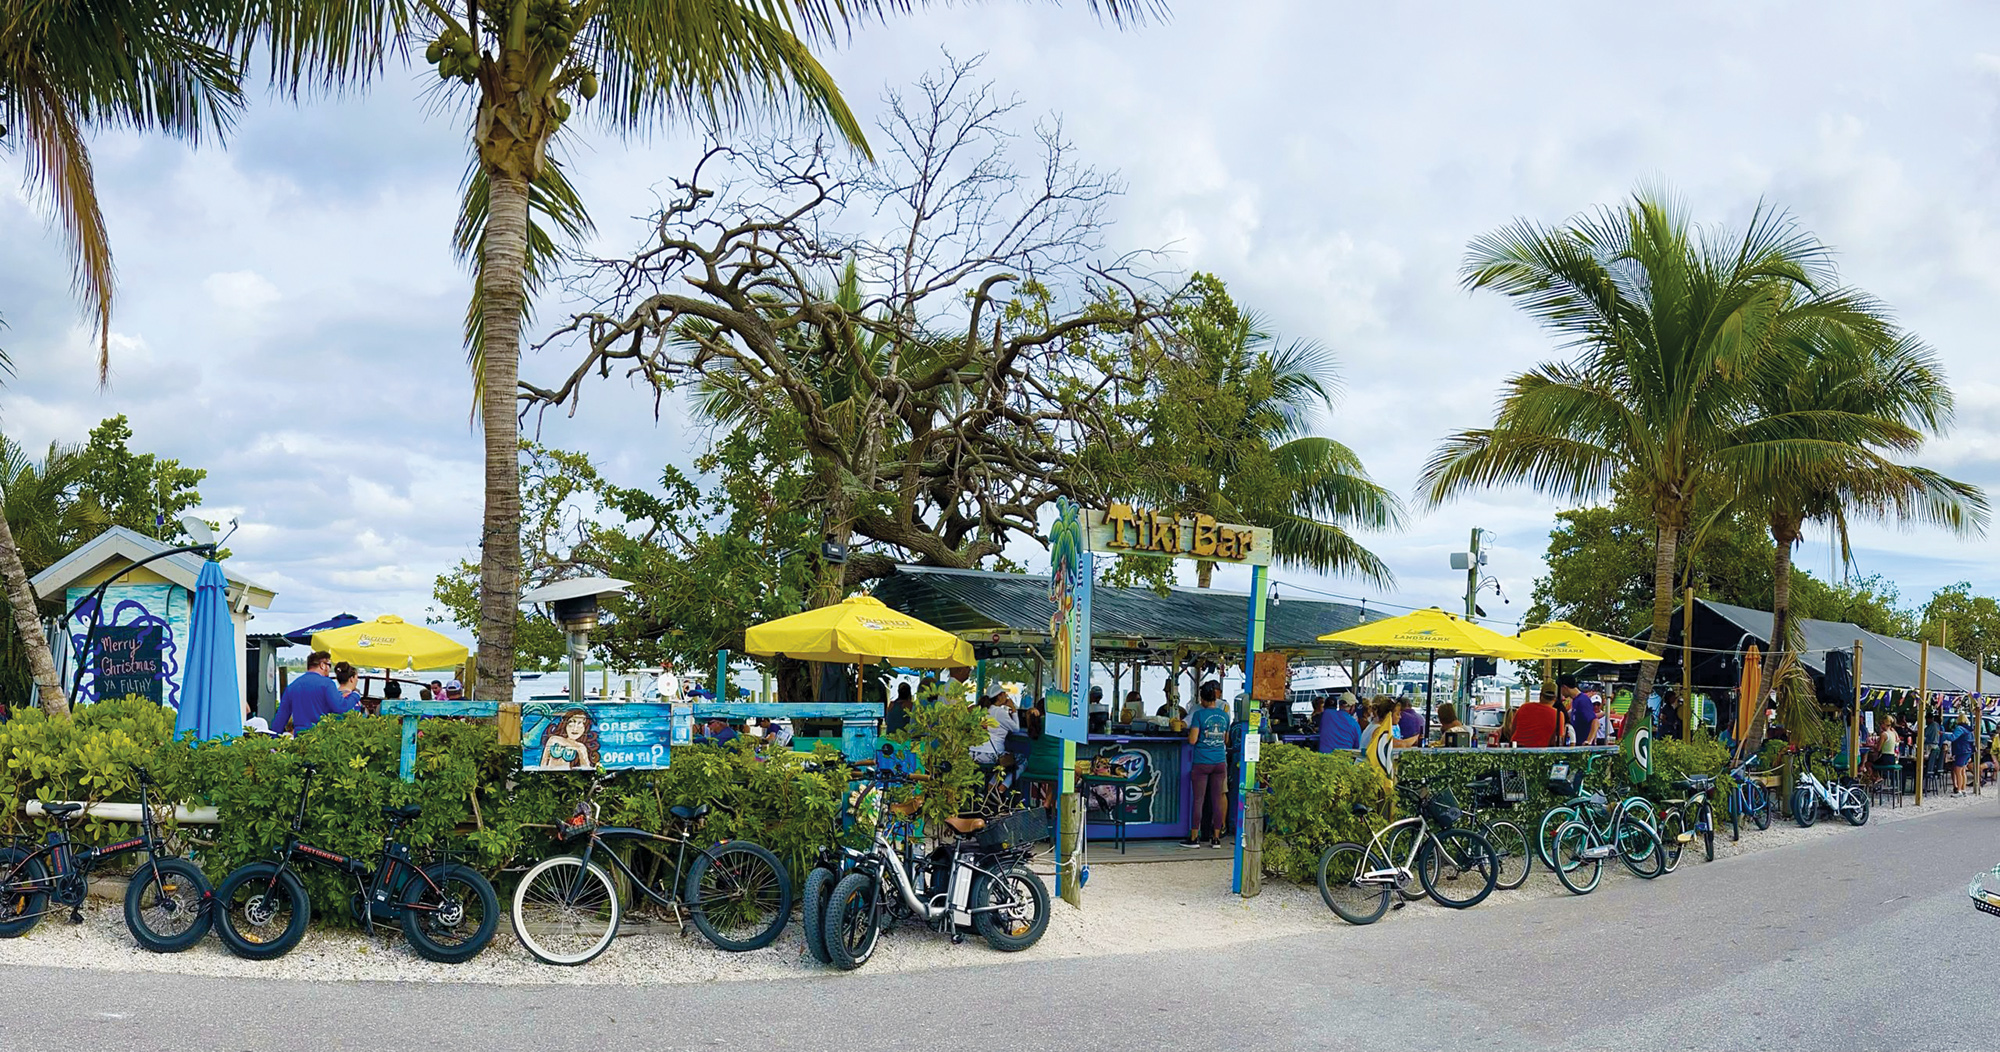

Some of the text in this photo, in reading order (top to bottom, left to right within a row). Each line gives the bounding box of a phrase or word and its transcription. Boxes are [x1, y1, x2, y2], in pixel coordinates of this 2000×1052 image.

[1102, 501, 1254, 560] Tiki Bar
[1074, 594, 1083, 657] Tender
[101, 636, 142, 658] Merry
[101, 656, 156, 676] Christmas
[104, 678, 152, 693] YA FILTHY
[1071, 662, 1081, 719] Bridge
[603, 752, 631, 763] OPEN
